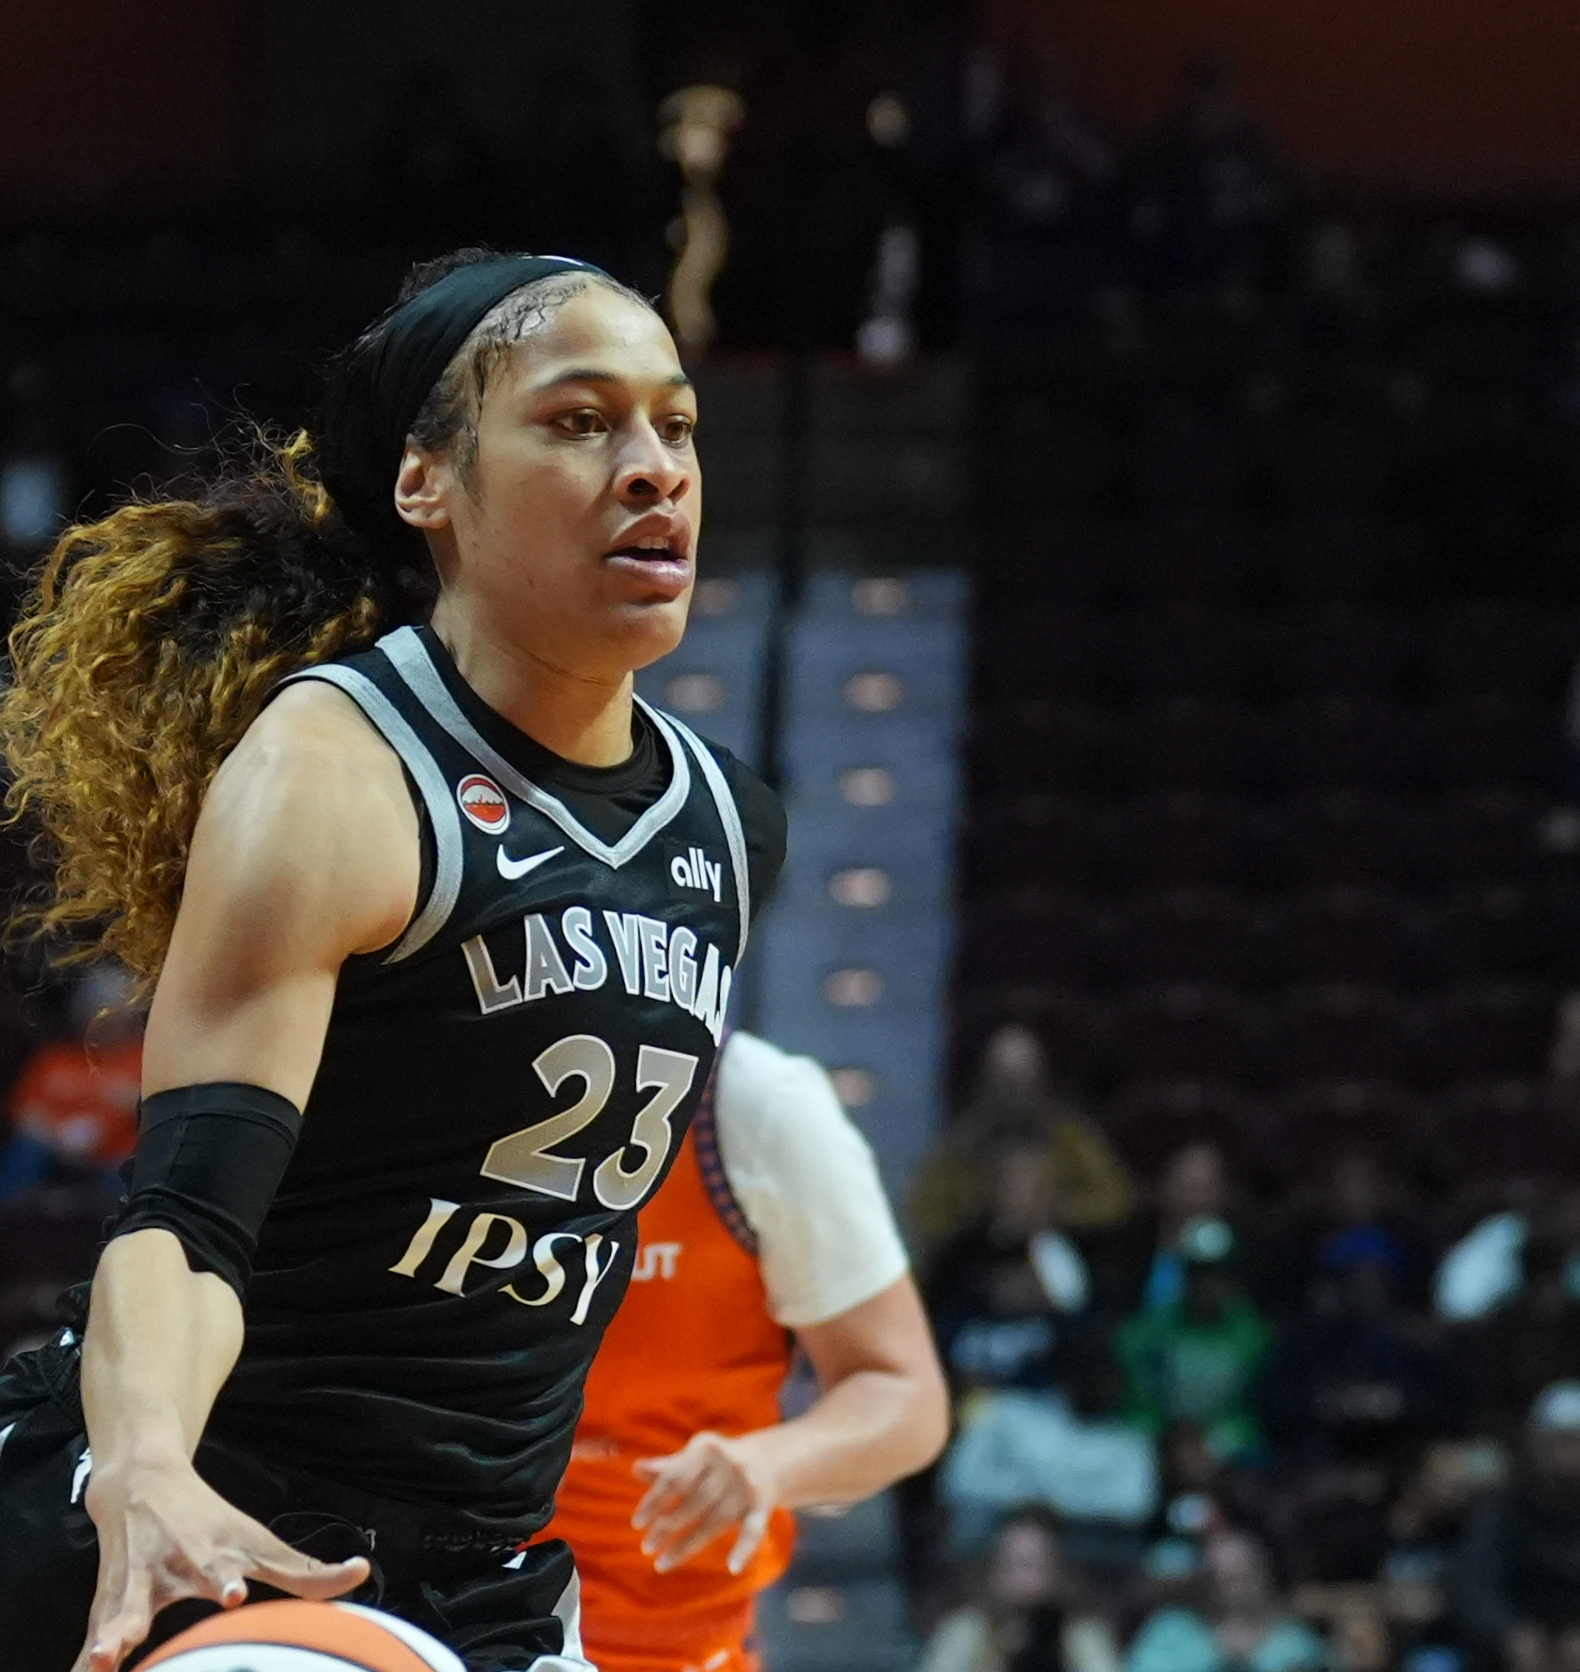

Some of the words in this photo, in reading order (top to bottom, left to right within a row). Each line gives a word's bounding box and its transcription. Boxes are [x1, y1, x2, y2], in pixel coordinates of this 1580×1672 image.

[670, 846, 721, 903] ally
[461, 906, 608, 1014] LAS
[479, 1033, 699, 1210] 23
[388, 1196, 619, 1326] IPSY
